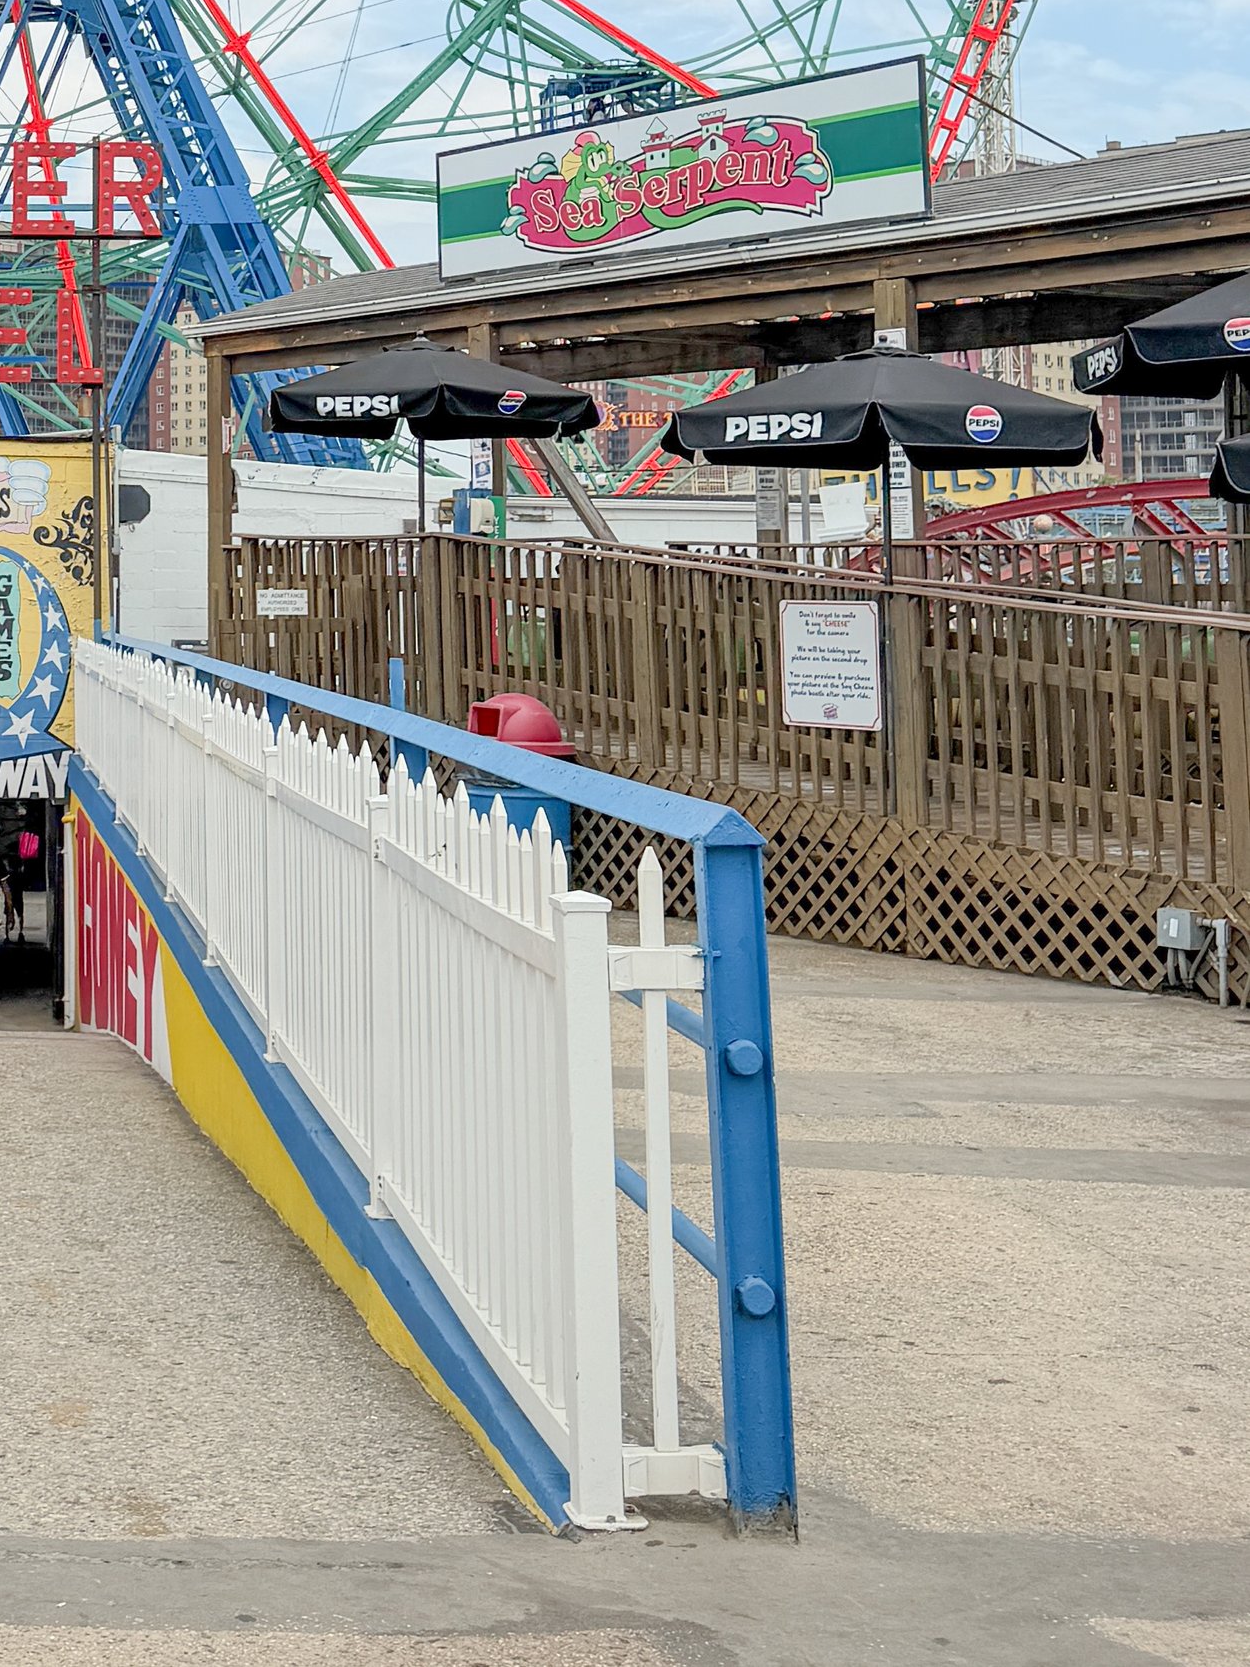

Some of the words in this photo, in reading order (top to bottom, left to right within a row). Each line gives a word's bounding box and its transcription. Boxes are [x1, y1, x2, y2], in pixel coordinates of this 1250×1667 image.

[528, 188, 605, 234] Sea
[614, 138, 791, 218] Serpent
[1227, 329, 1250, 337] PEP
[1087, 346, 1118, 380] PEPSI
[316, 394, 399, 417] PEPSI
[619, 412, 658, 427] THE
[969, 419, 999, 428] PEPSI
[725, 412, 822, 442] PEPSI
[815, 612, 832, 620] forget
[811, 621, 821, 629] say
[827, 646, 845, 655] taking
[791, 655, 810, 663] picture
[853, 657, 868, 665] drop
[844, 674, 870, 682] purchase
[801, 681, 821, 689] picture
[841, 683, 852, 692] Say
[76, 807, 160, 1062] CONEY
